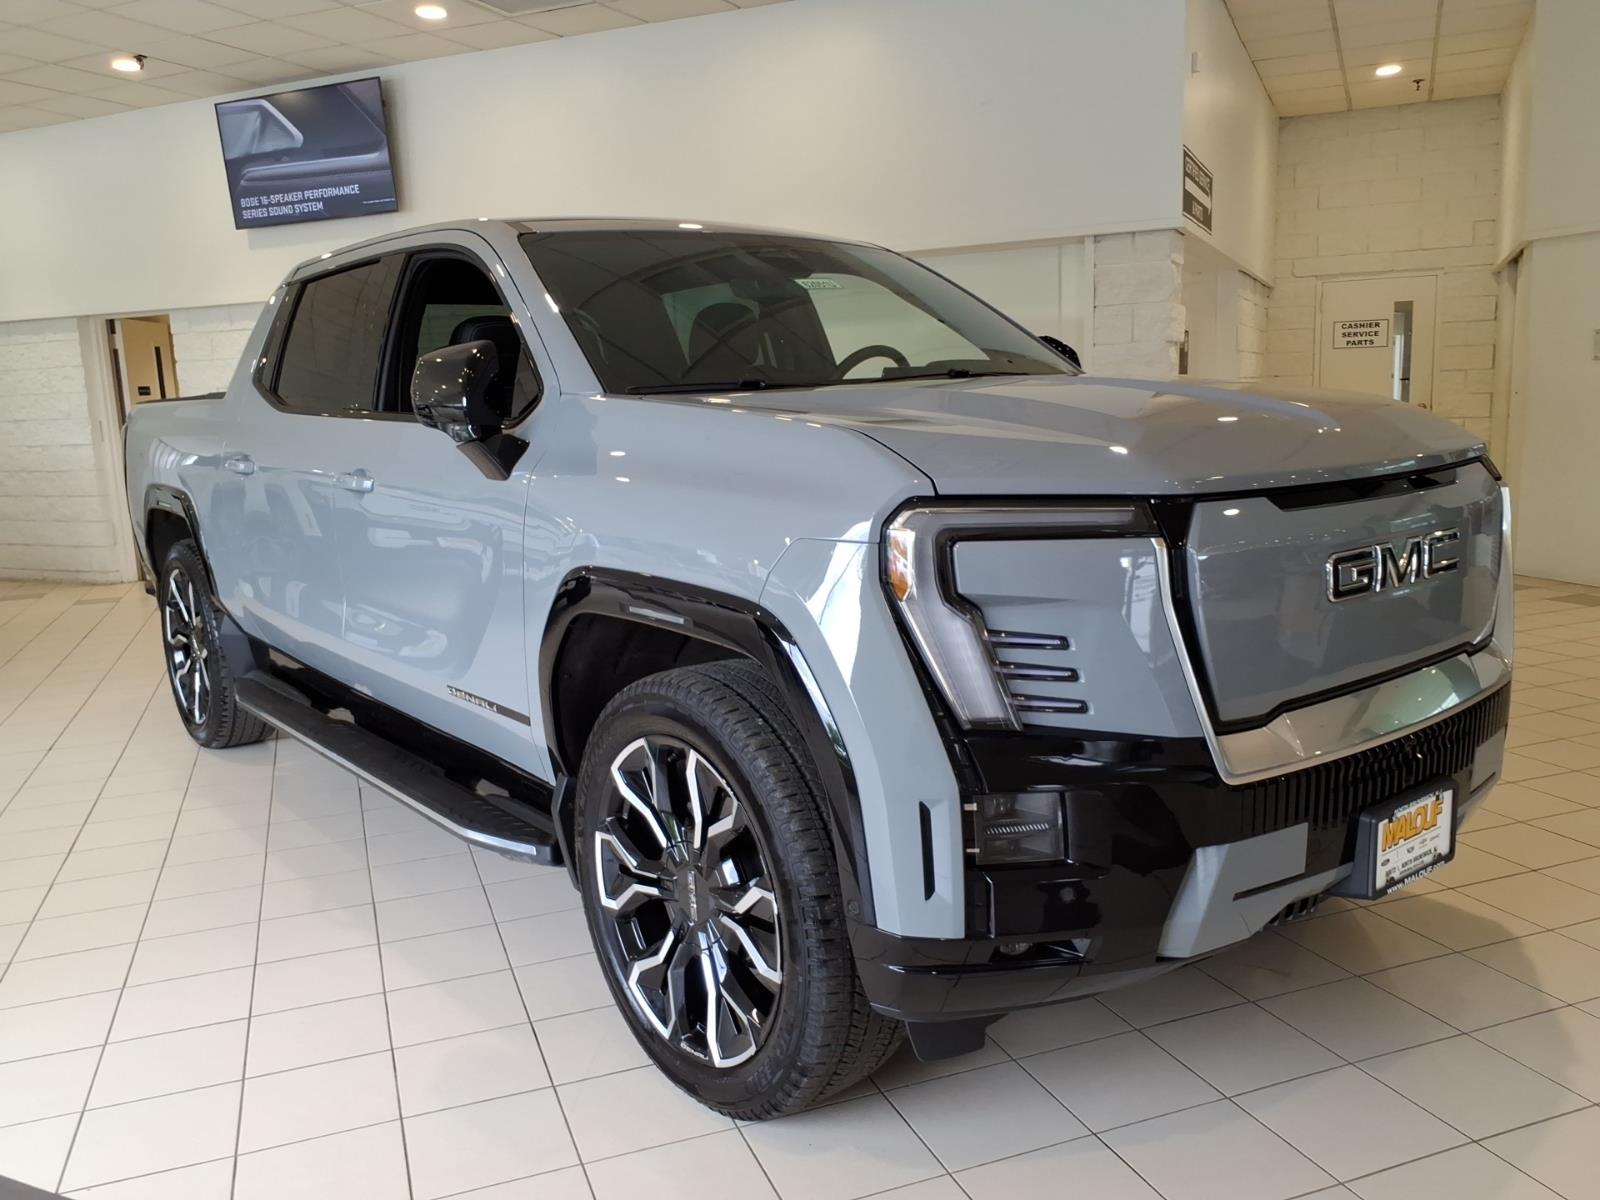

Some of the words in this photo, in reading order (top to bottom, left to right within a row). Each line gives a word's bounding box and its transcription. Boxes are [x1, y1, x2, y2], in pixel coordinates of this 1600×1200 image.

[240, 198, 259, 208] BOSE
[260, 191, 303, 206] 16-SPEAKER
[304, 184, 360, 199] PERFORMANCE
[242, 208, 268, 219] SERIES
[269, 205, 294, 216] SOUND
[294, 201, 325, 214] SYSTEM
[1341, 321, 1381, 329] CASHIER
[1341, 330, 1380, 338] SERVICE
[1326, 527, 1460, 602] GMC
[1382, 799, 1444, 852] MALOUF
